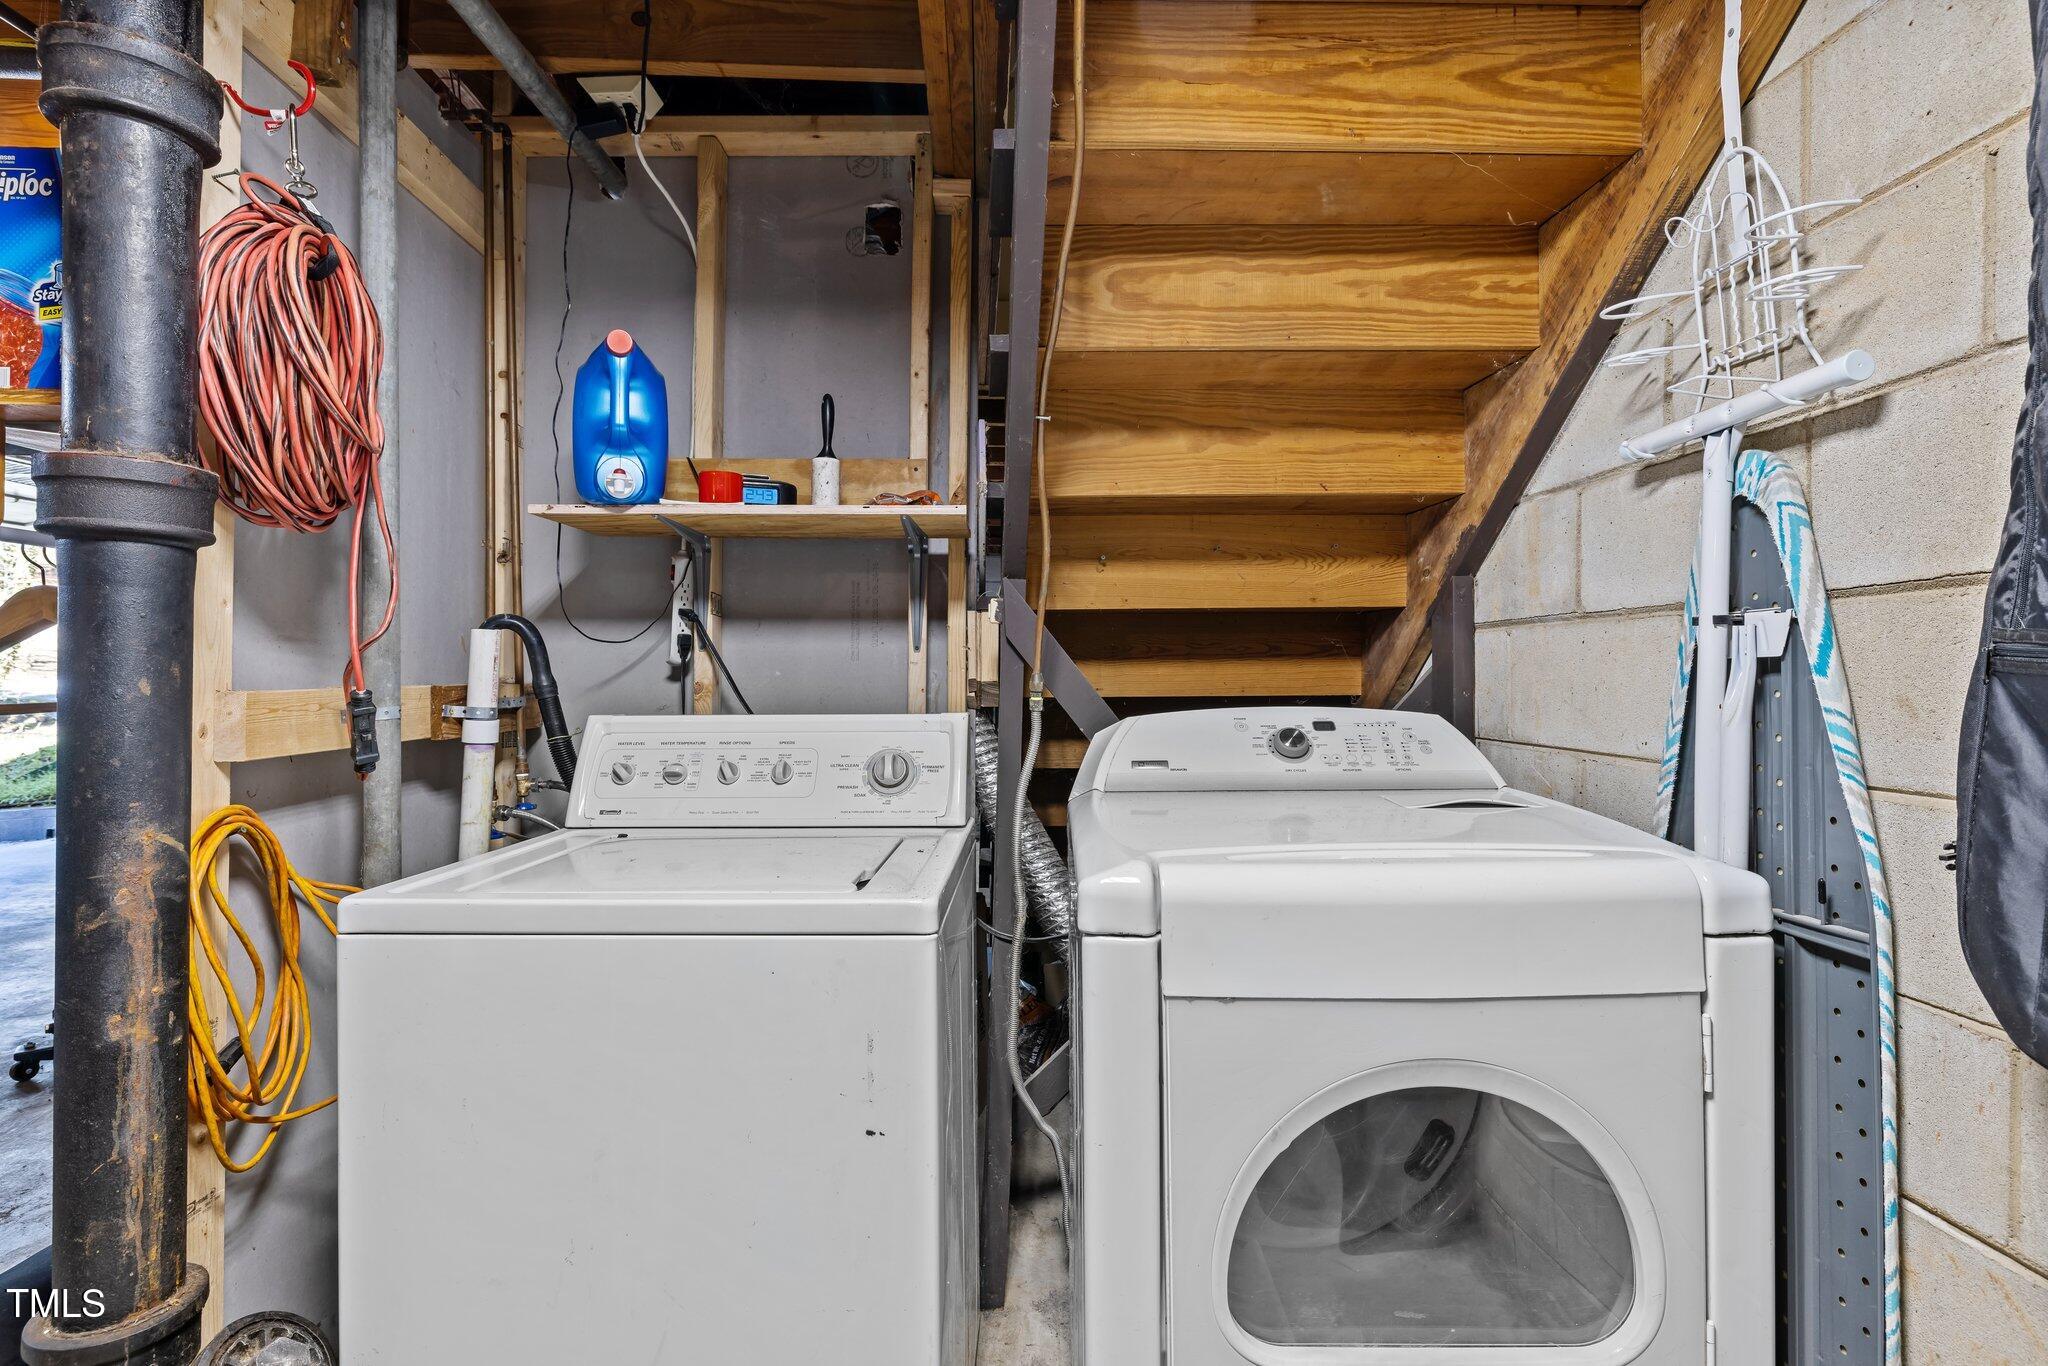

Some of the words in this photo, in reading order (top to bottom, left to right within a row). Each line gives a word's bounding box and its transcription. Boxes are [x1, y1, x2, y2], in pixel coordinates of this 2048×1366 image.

[0, 171, 53, 201] iploc
[33, 289, 62, 302] Stay
[42, 308, 62, 316] EASY
